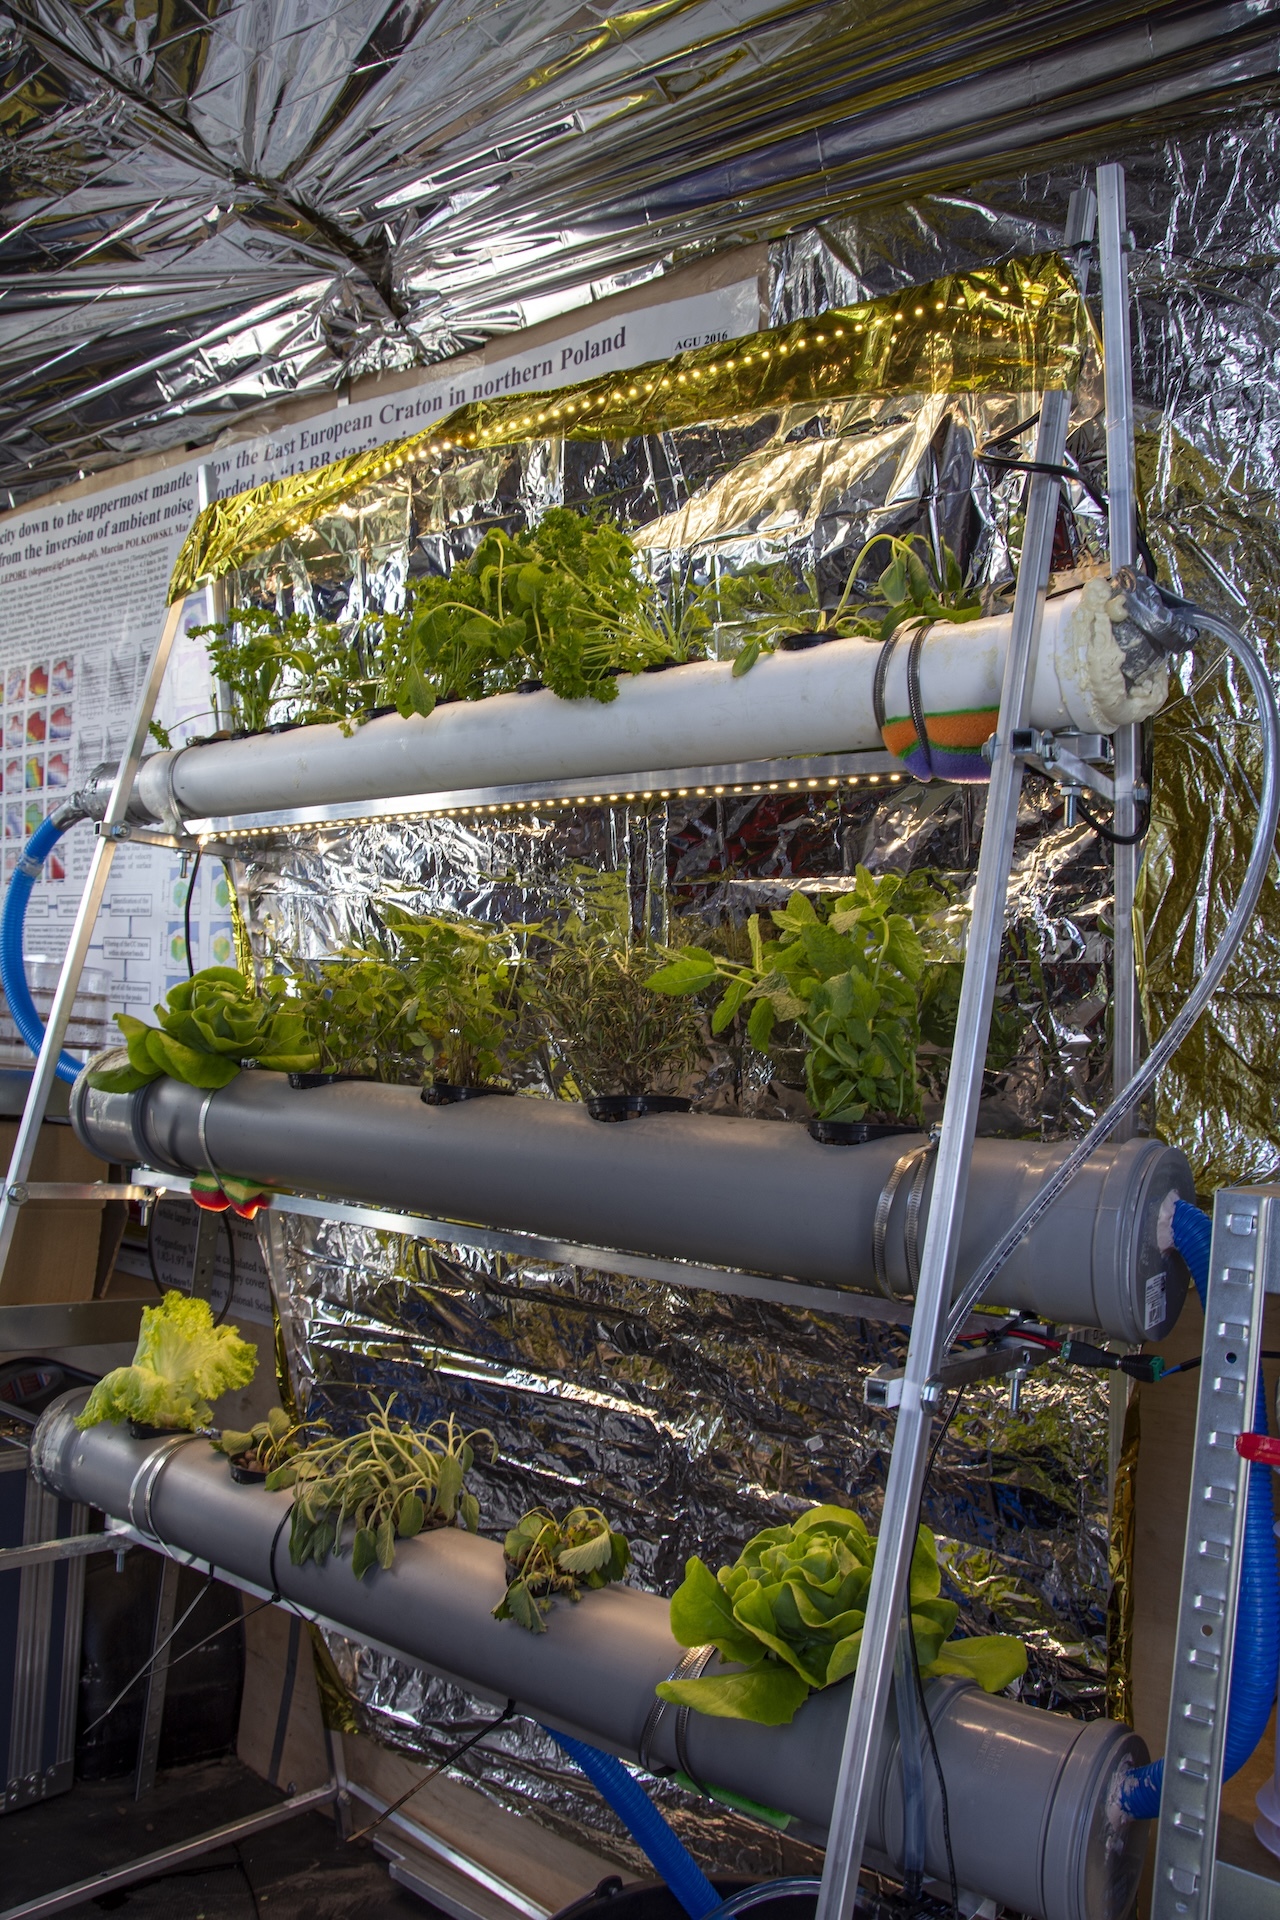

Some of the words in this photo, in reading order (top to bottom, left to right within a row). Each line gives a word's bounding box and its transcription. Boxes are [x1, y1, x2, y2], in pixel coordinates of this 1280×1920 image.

[674, 335, 701, 351] AGU
[704, 329, 728, 346] 2016
[19, 520, 49, 538] down
[53, 514, 64, 530] to
[67, 508, 83, 525] the
[86, 487, 149, 520] uppermost
[152, 471, 193, 499] mantle
[236, 447, 258, 470] the
[264, 438, 296, 462] East
[300, 414, 373, 451] European
[379, 391, 443, 424] Craton
[449, 386, 466, 408] in
[472, 359, 553, 402] northern
[560, 326, 627, 370] Poland
[0, 551, 22, 568] from
[25, 544, 42, 561] the
[46, 528, 93, 556] inversion
[96, 521, 110, 540] of
[111, 506, 161, 535] ambient
[163, 497, 194, 518] noise
[0, 569, 28, 585] LEPORE
